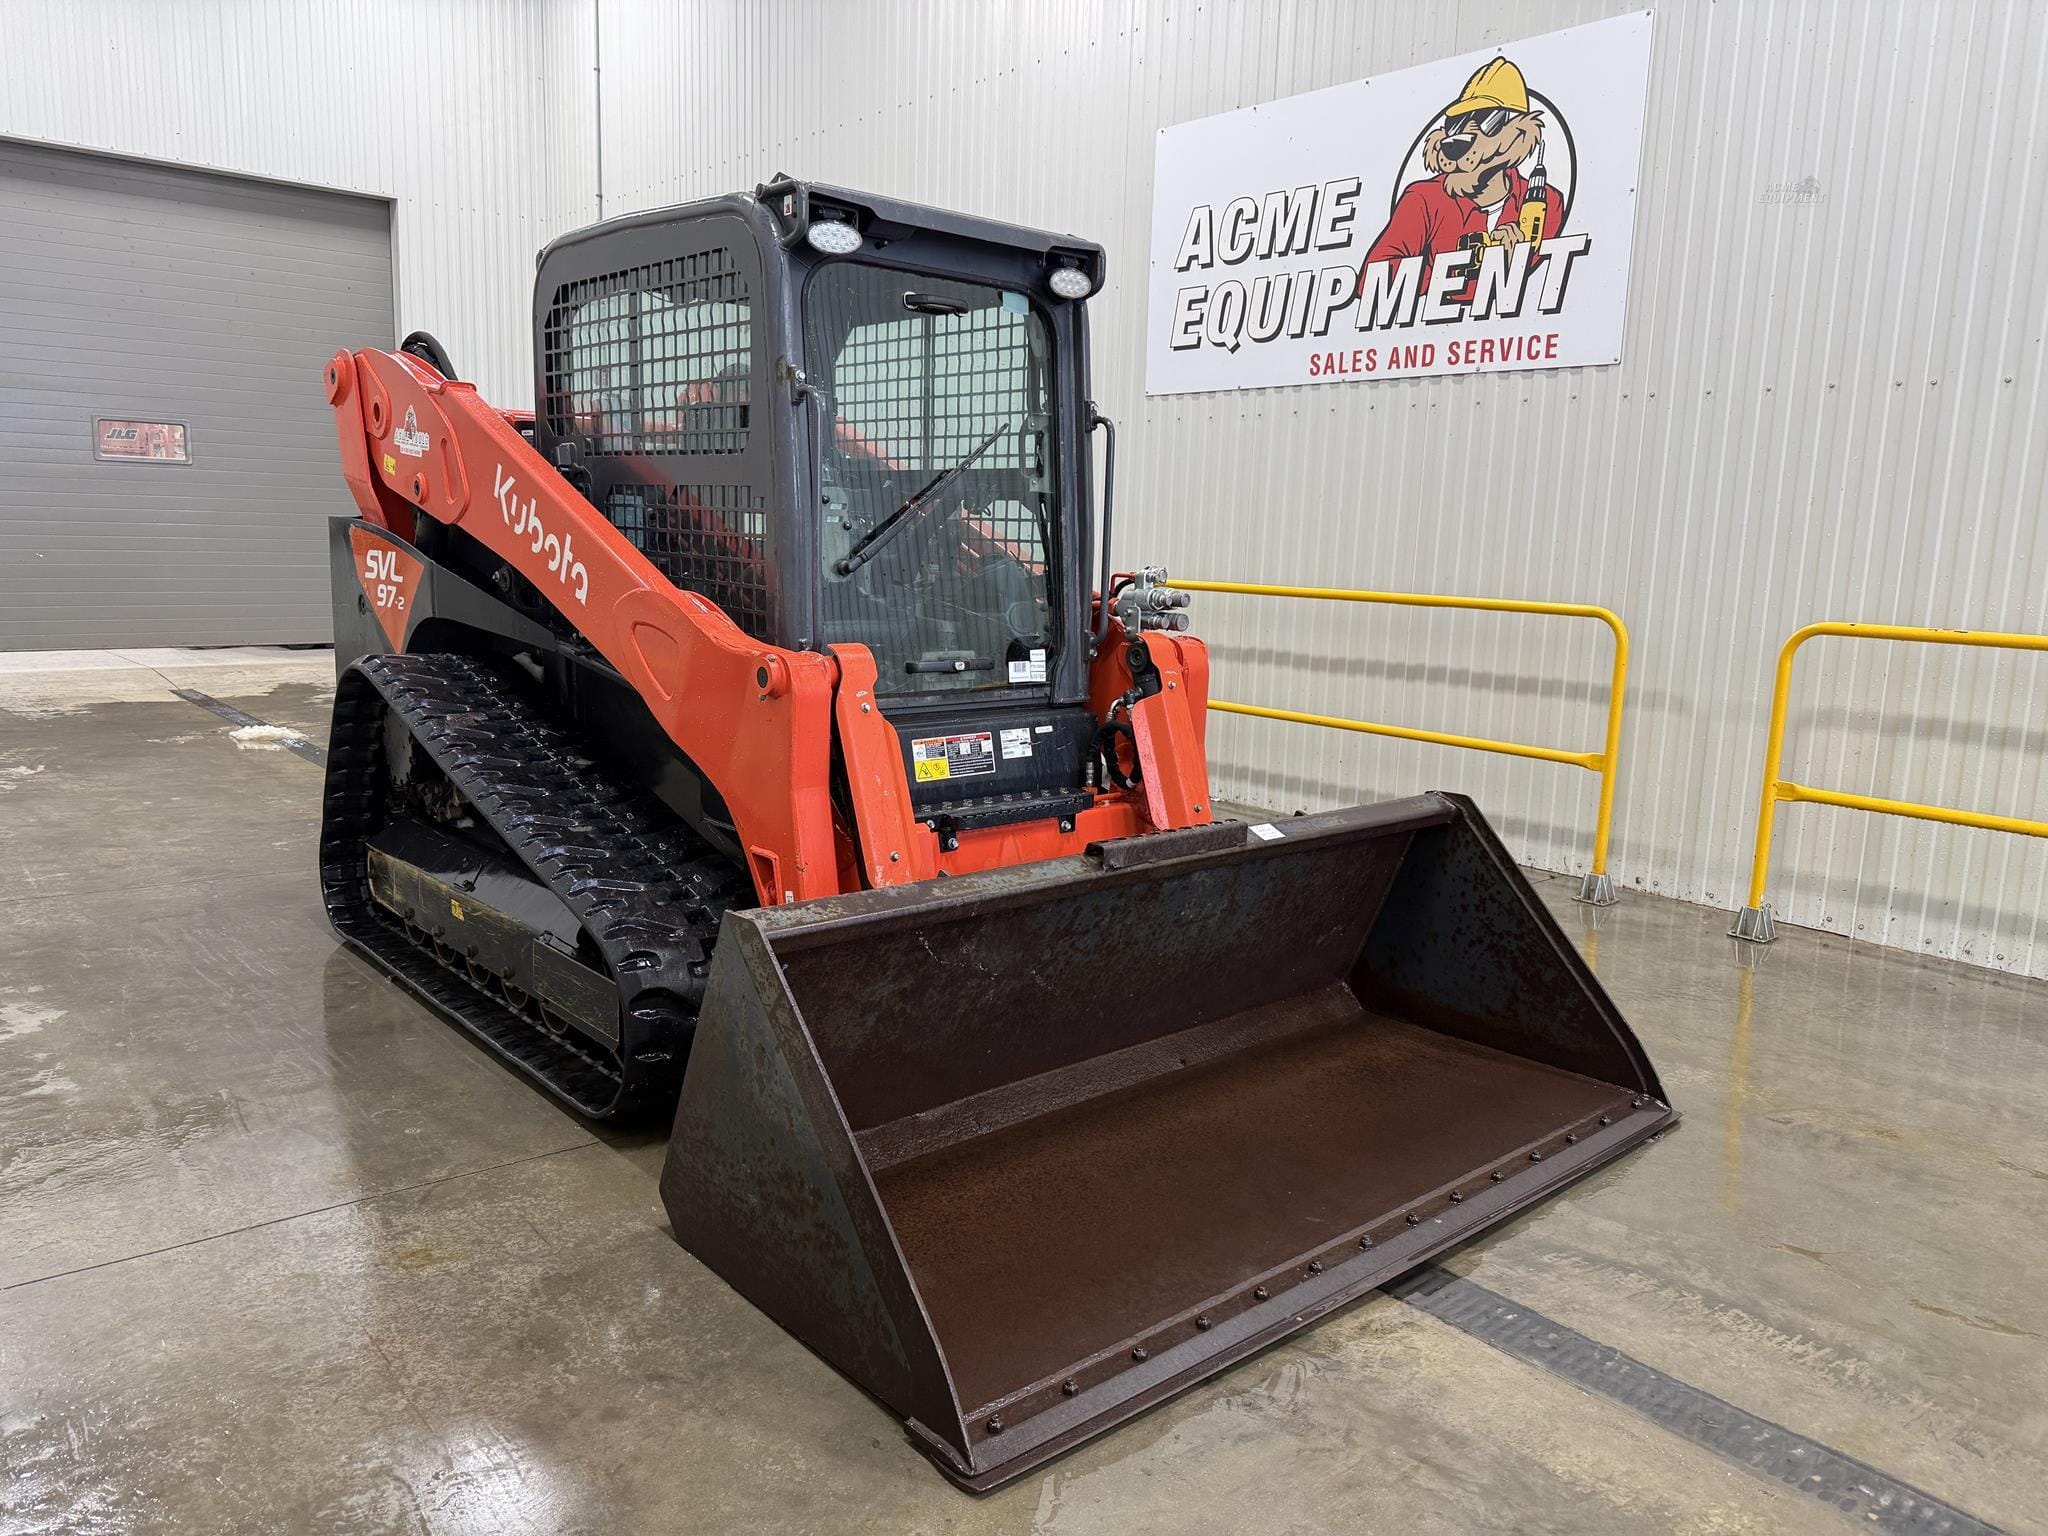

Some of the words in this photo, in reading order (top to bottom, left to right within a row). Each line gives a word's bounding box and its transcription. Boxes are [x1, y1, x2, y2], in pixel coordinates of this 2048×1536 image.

[1173, 176, 1361, 273] ACME
[1169, 232, 1592, 355] EQUIPMENT
[1308, 342, 1378, 377] SALES
[1387, 342, 1436, 370] AND
[1446, 333, 1560, 366] SERVICE
[104, 427, 139, 441] JLG
[364, 549, 404, 582] SVL
[493, 464, 588, 605] Kubota
